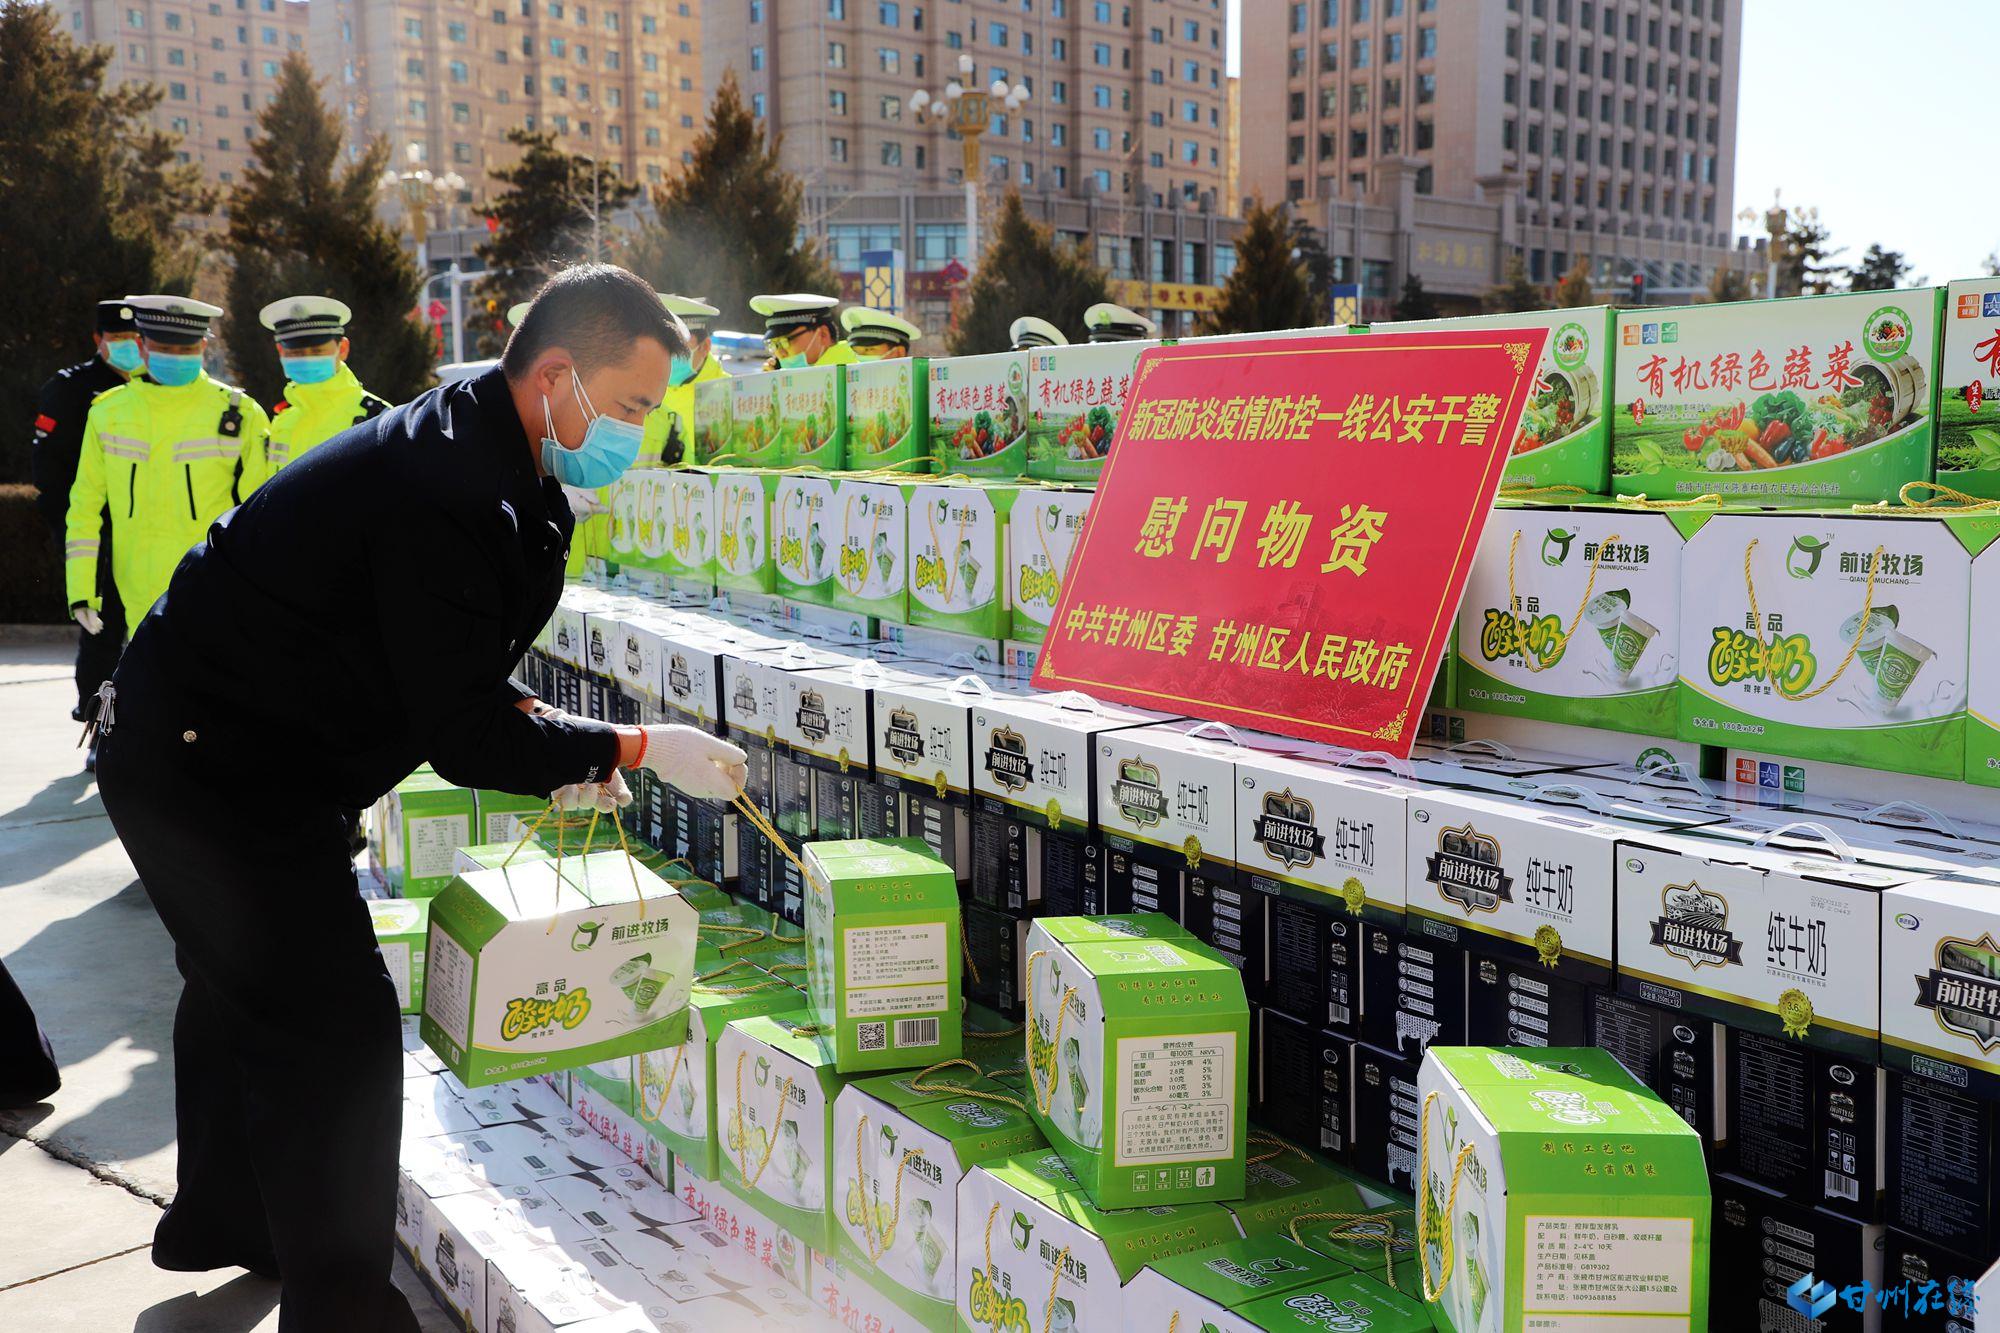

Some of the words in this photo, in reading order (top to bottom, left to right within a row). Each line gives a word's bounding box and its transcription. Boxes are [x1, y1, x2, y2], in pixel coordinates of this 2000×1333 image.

[1039, 374, 1130, 408] 有机绿色蔬菜
[1637, 340, 1864, 400] 有机绿色蔬菜
[1128, 393, 1500, 446] 新冠肺炎疫情防控一线公安干警
[1134, 495, 1388, 577] 慰问物资
[1584, 543, 1649, 564] 前进牧场
[1839, 551, 1924, 577] 前进牧场
[1064, 602, 1198, 657] 中共甘州区委
[1210, 621, 1412, 691] 甘州区人民政府
[1709, 626, 1817, 695] 酸牛奶
[991, 752, 1027, 775] 前进牧场
[1119, 784, 1160, 809] 前进牧场
[1177, 780, 1208, 825] 纯牛奶
[1263, 819, 1315, 848] 前进牧场
[1335, 817, 1374, 867] 纯牛奶
[1439, 859, 1500, 891] 前进牧场
[1525, 856, 1573, 914] 纯牛奶
[611, 917, 670, 942] 前进牧场
[1663, 922, 1729, 954] 前进牧场
[1767, 910, 1827, 976] 纯牛奶
[535, 978, 567, 996] 高品
[501, 988, 592, 1041] 酸牛奶
[1039, 1239, 1088, 1284] 前进牧场
